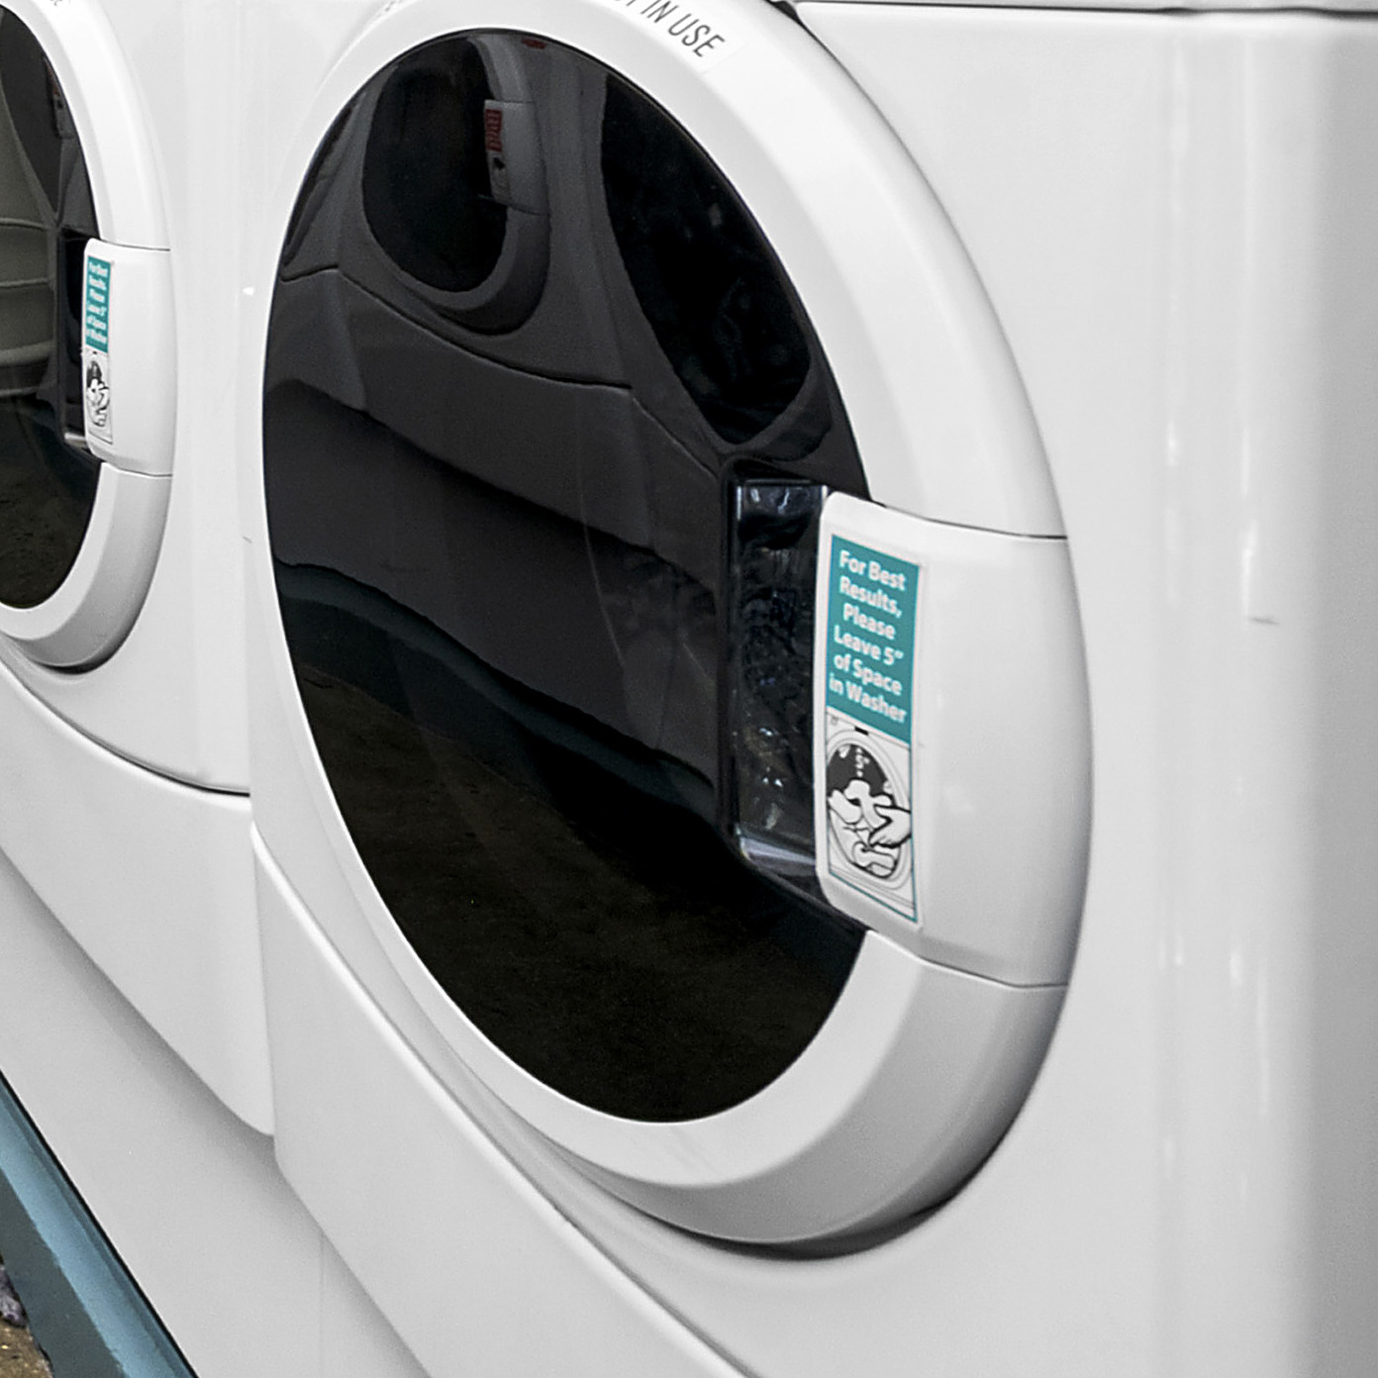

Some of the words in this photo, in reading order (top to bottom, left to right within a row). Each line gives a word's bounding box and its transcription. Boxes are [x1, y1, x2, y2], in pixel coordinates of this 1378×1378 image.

[667, 13, 725, 58] USE
[839, 550, 866, 575] For
[868, 561, 907, 591] Best
[839, 576, 902, 617] Results,
[843, 603, 896, 640] Please
[834, 625, 881, 660] Leave
[884, 647, 904, 665] 5"
[834, 653, 852, 672] of
[852, 660, 903, 695] Space
[829, 674, 844, 695] in
[846, 682, 907, 723] Washer
